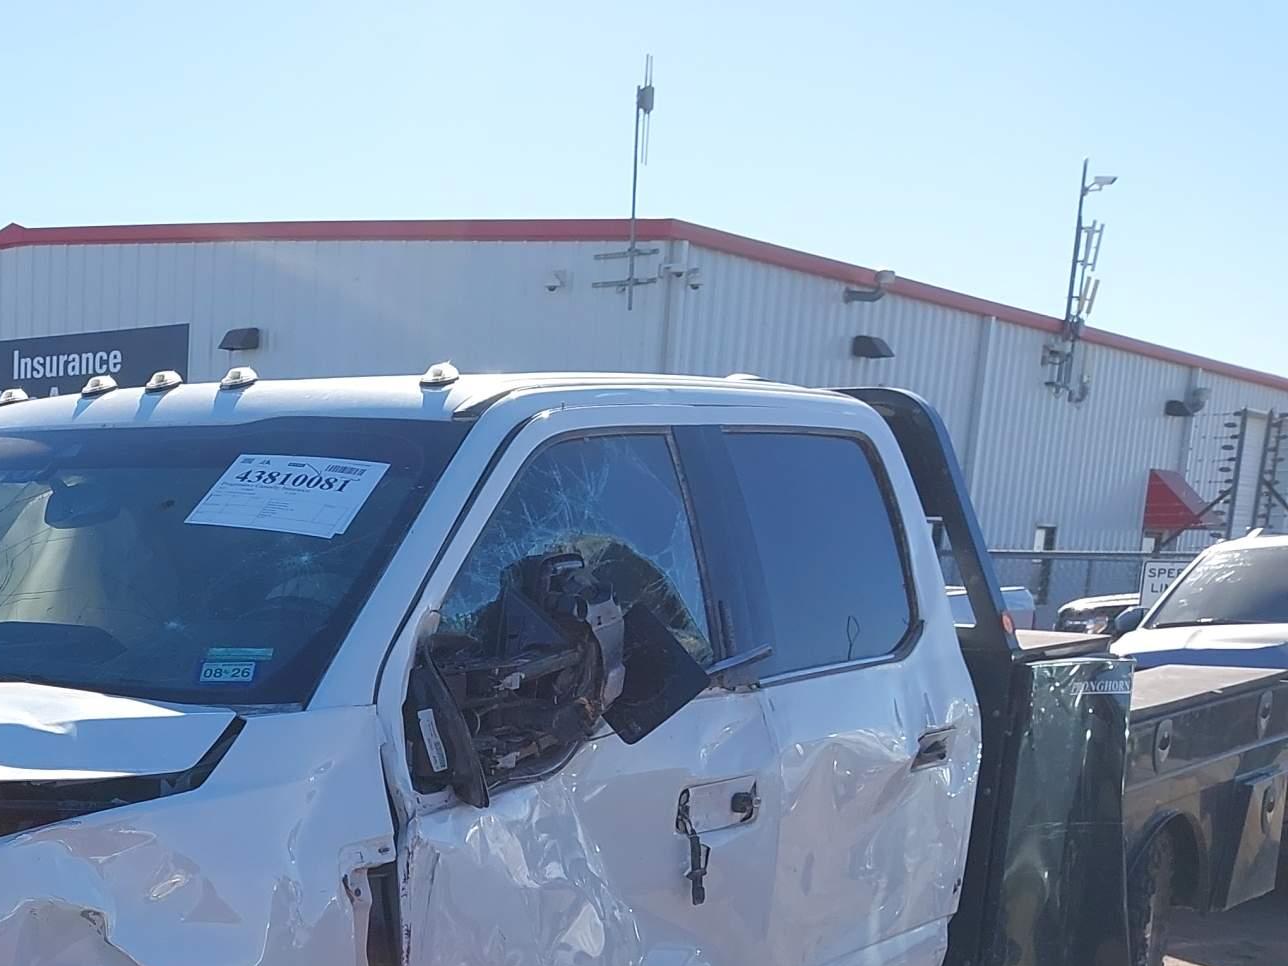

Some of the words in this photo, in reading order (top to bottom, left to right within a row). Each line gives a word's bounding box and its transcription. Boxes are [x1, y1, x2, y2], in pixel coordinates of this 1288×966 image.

[13, 350, 122, 380] Insurance
[235, 470, 352, 492] 43810081
[1148, 567, 1184, 578] SPE
[231, 668, 251, 678] 26
